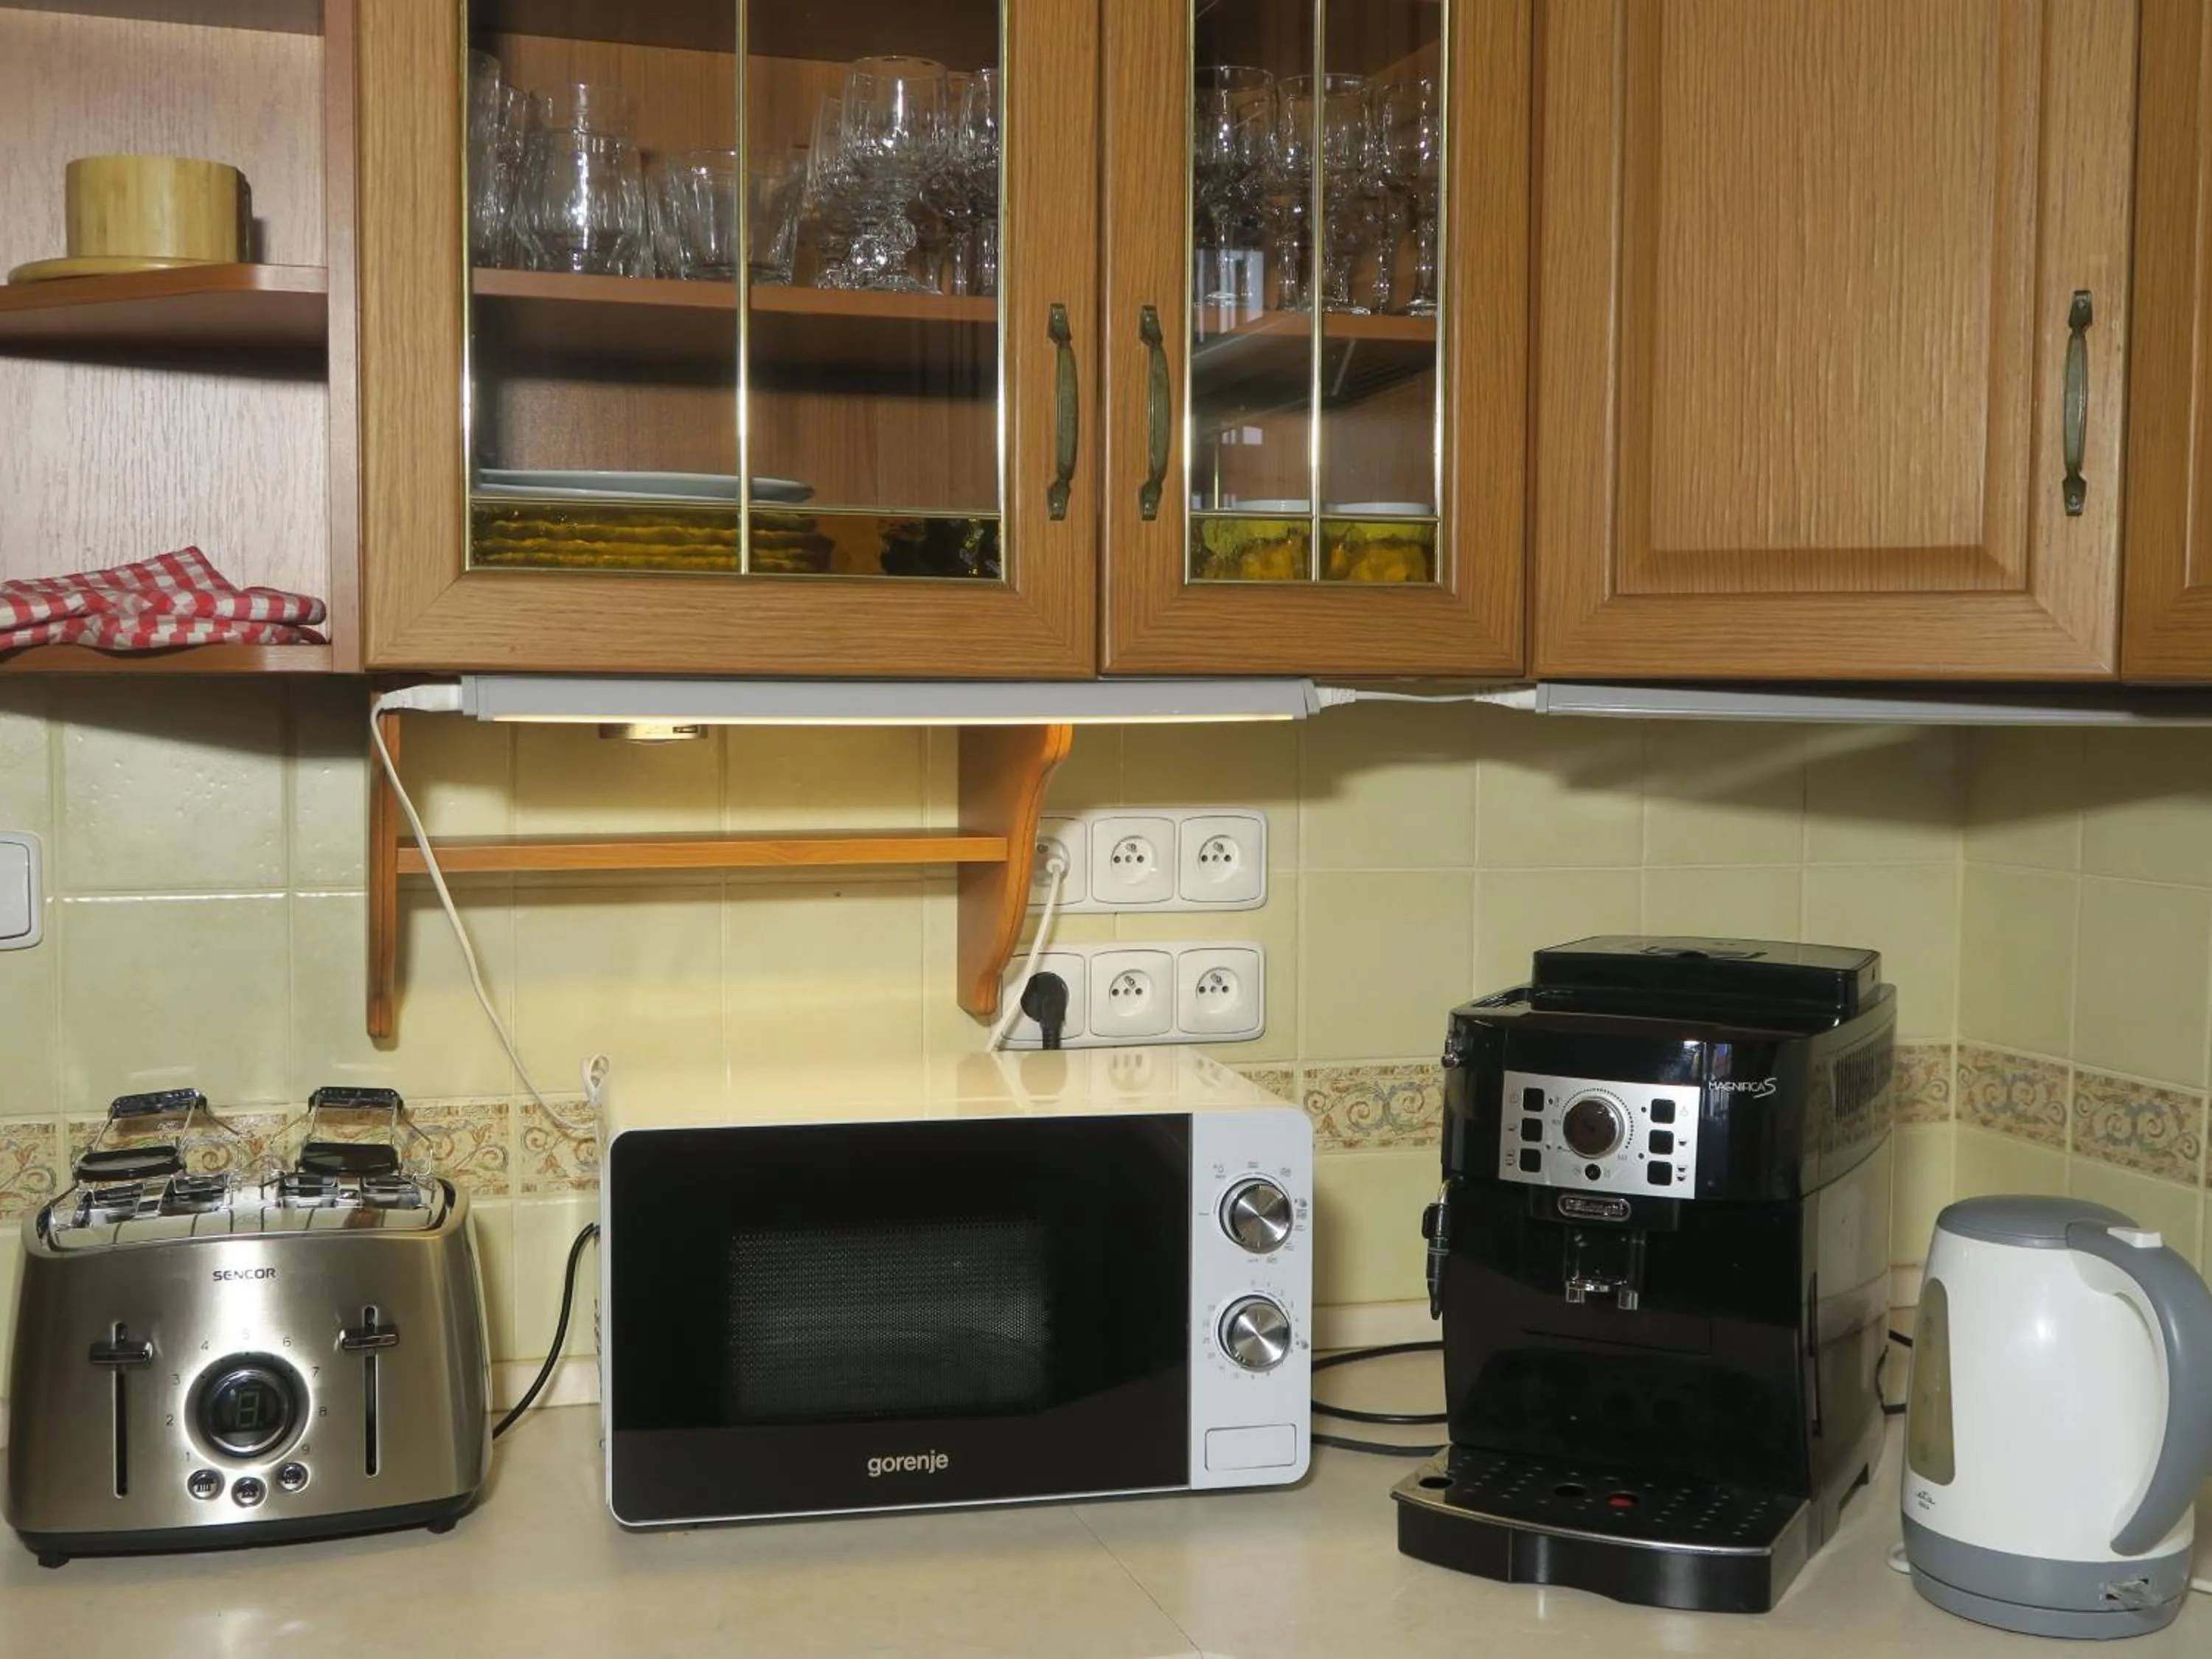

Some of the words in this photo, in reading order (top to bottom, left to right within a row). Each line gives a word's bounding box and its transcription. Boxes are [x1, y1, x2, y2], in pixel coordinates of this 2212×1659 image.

[212, 1267, 277, 1281] SENCOR
[200, 1340, 209, 1351] 4
[282, 1337, 292, 1348] 6
[310, 1366, 320, 1378] 7
[170, 1373, 181, 1386] 3
[165, 1413, 175, 1427] 2
[300, 1444, 310, 1455] 9
[867, 1449, 949, 1478] gorenje
